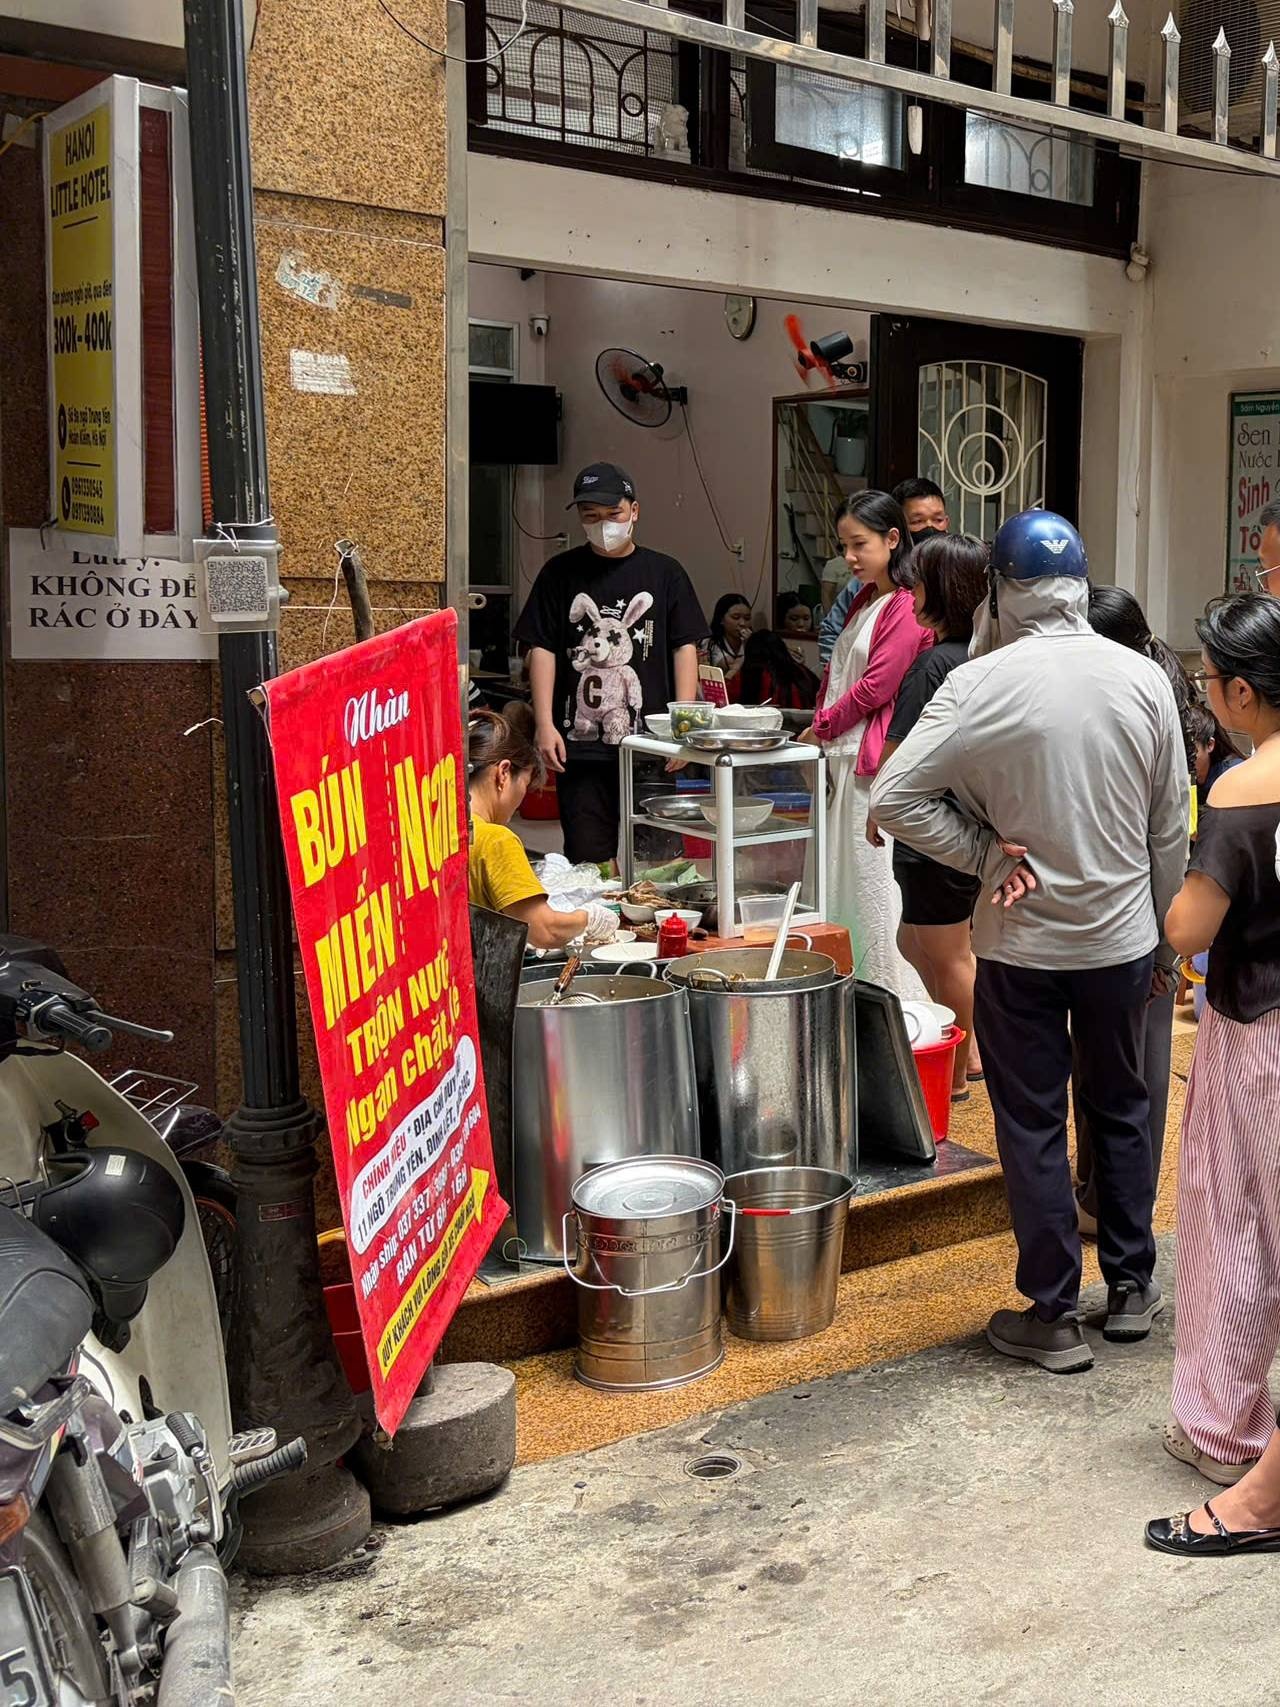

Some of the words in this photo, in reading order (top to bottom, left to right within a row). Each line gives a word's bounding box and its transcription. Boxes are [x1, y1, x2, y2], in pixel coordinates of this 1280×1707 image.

[65, 121, 95, 167] HANOI
[50, 177, 79, 218] LITTLE
[80, 164, 111, 208] HOTEL
[1237, 422, 1271, 446] Sen
[1239, 450, 1272, 469] Nước
[1238, 476, 1270, 518] Sinh
[31, 570, 150, 599] KHÔNG
[28, 602, 97, 629] RÁC
[106, 602, 130, 629] Ở
[138, 603, 198, 629] ĐÂY
[343, 687, 411, 747] Nhàn
[583, 675, 603, 709] C
[290, 754, 368, 889] BÚN
[315, 869, 396, 1032] MIẾN
[346, 984, 405, 1077] TRỘN
[345, 1067, 399, 1157] Ngan
[361, 1154, 391, 1200] CHÍNH
[413, 1109, 432, 1138] ĐỊA
[366, 1196, 385, 1225] NGÕ
[396, 1240, 418, 1286] BÁN
[417, 1213, 436, 1251] TỪ
